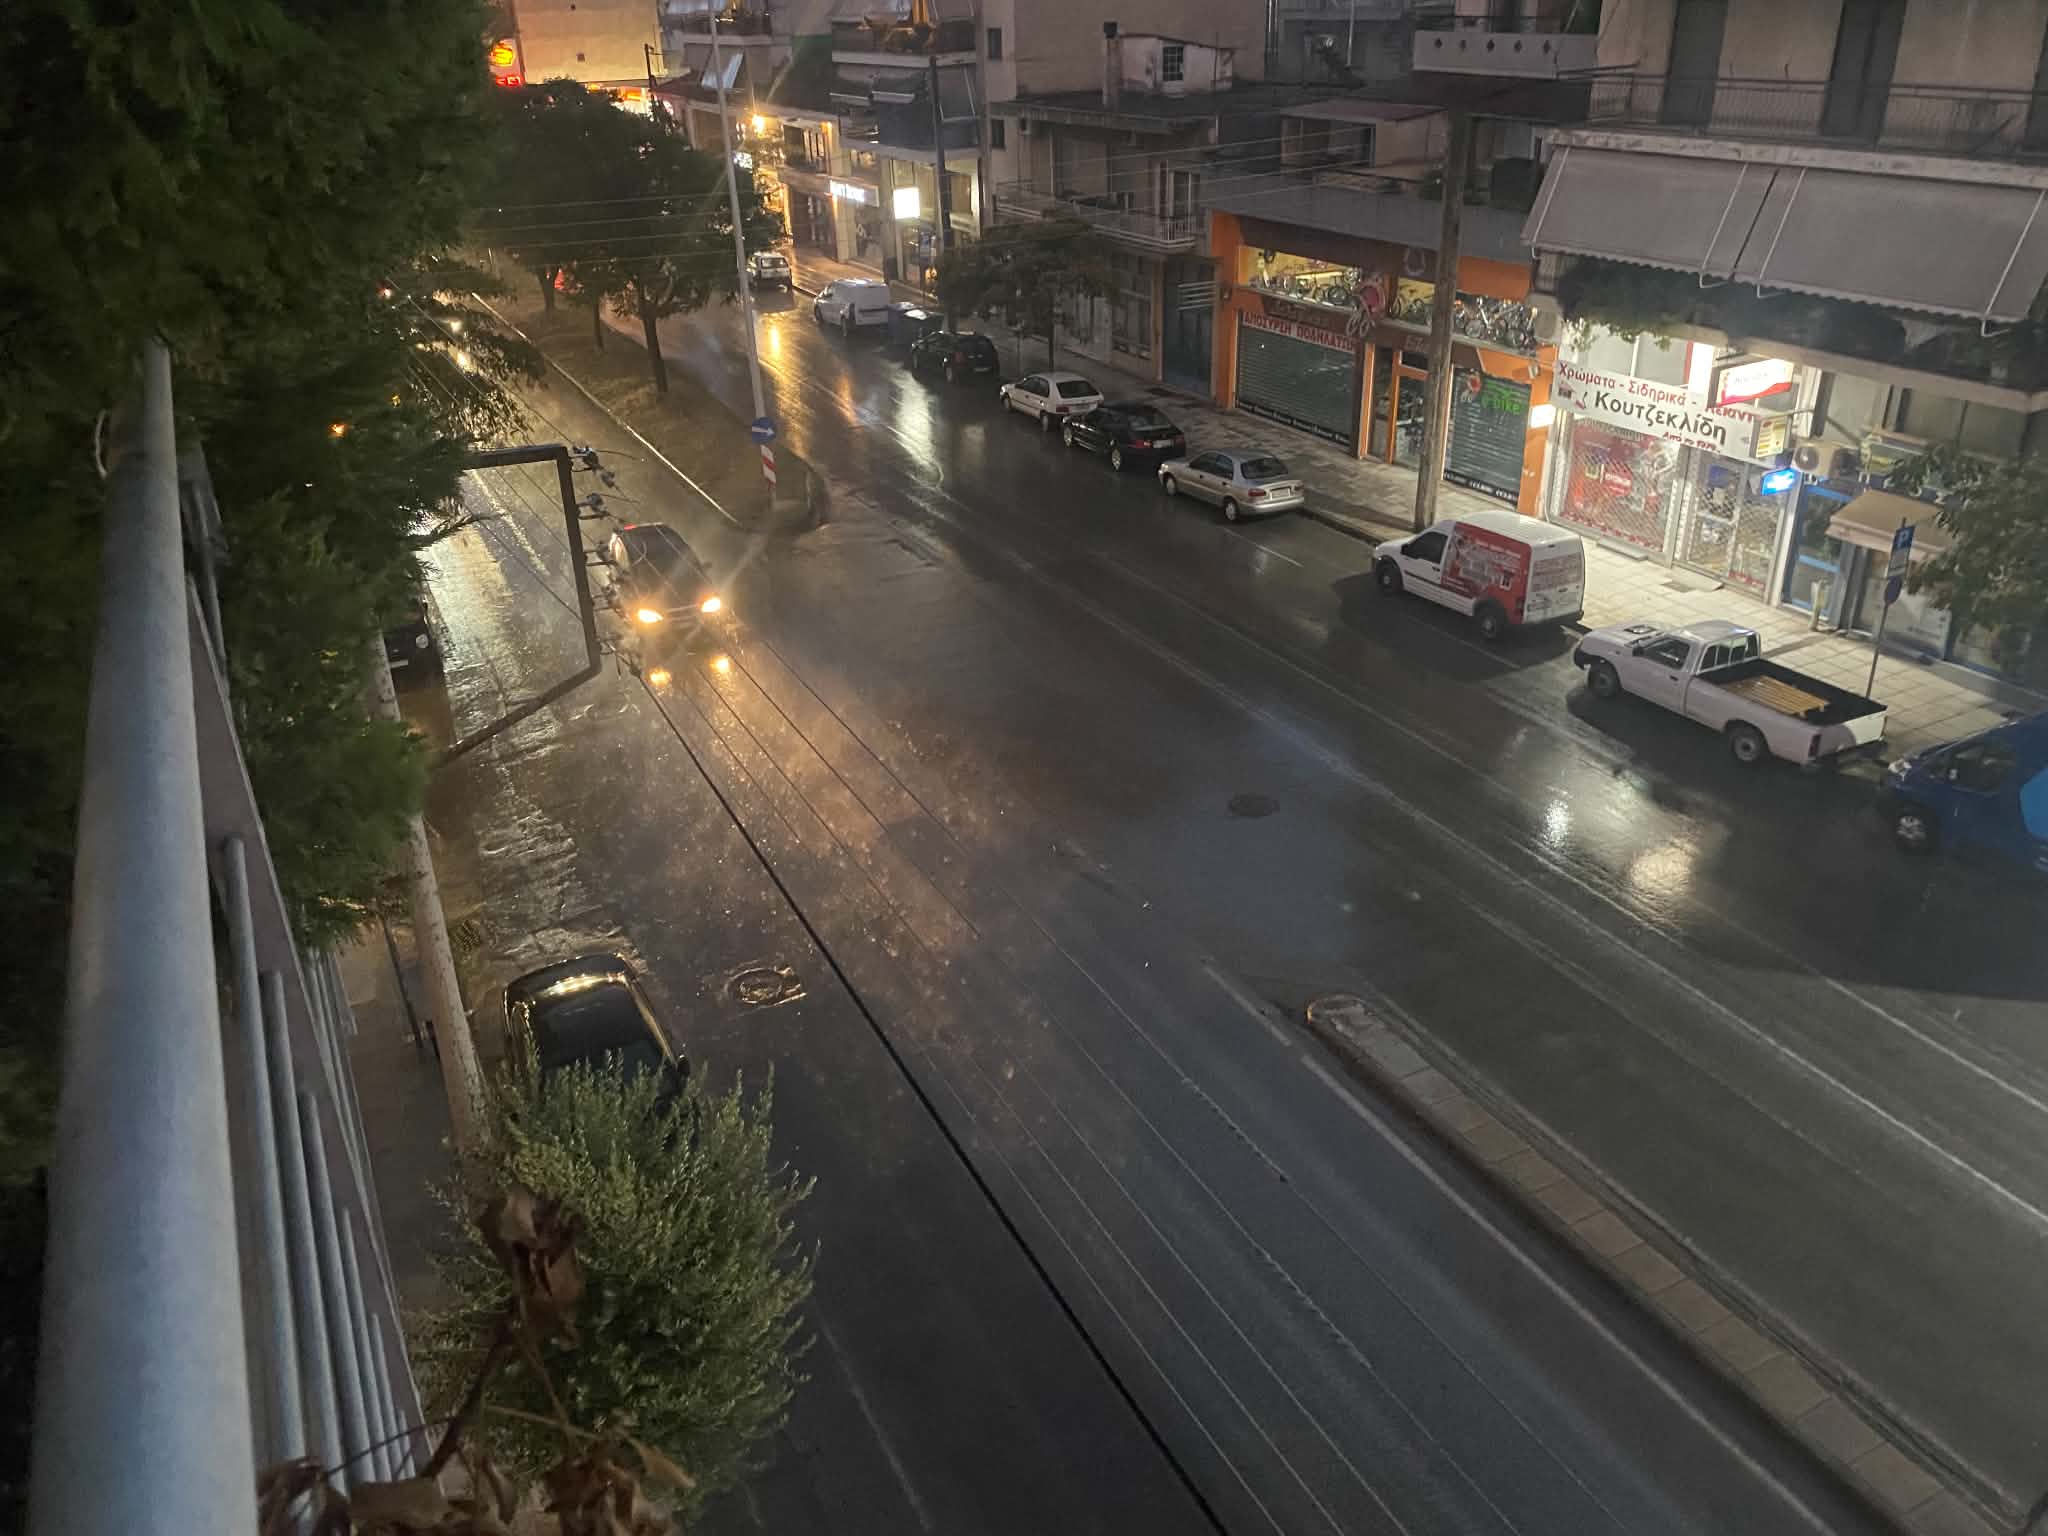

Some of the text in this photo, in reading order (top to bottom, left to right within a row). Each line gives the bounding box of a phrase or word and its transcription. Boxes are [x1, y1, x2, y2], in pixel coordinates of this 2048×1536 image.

[1559, 362, 1616, 389] Χρώματα
[1628, 380, 1687, 407] Σιδηρικά
[1594, 391, 1727, 446] Κουτζεκλίδη
